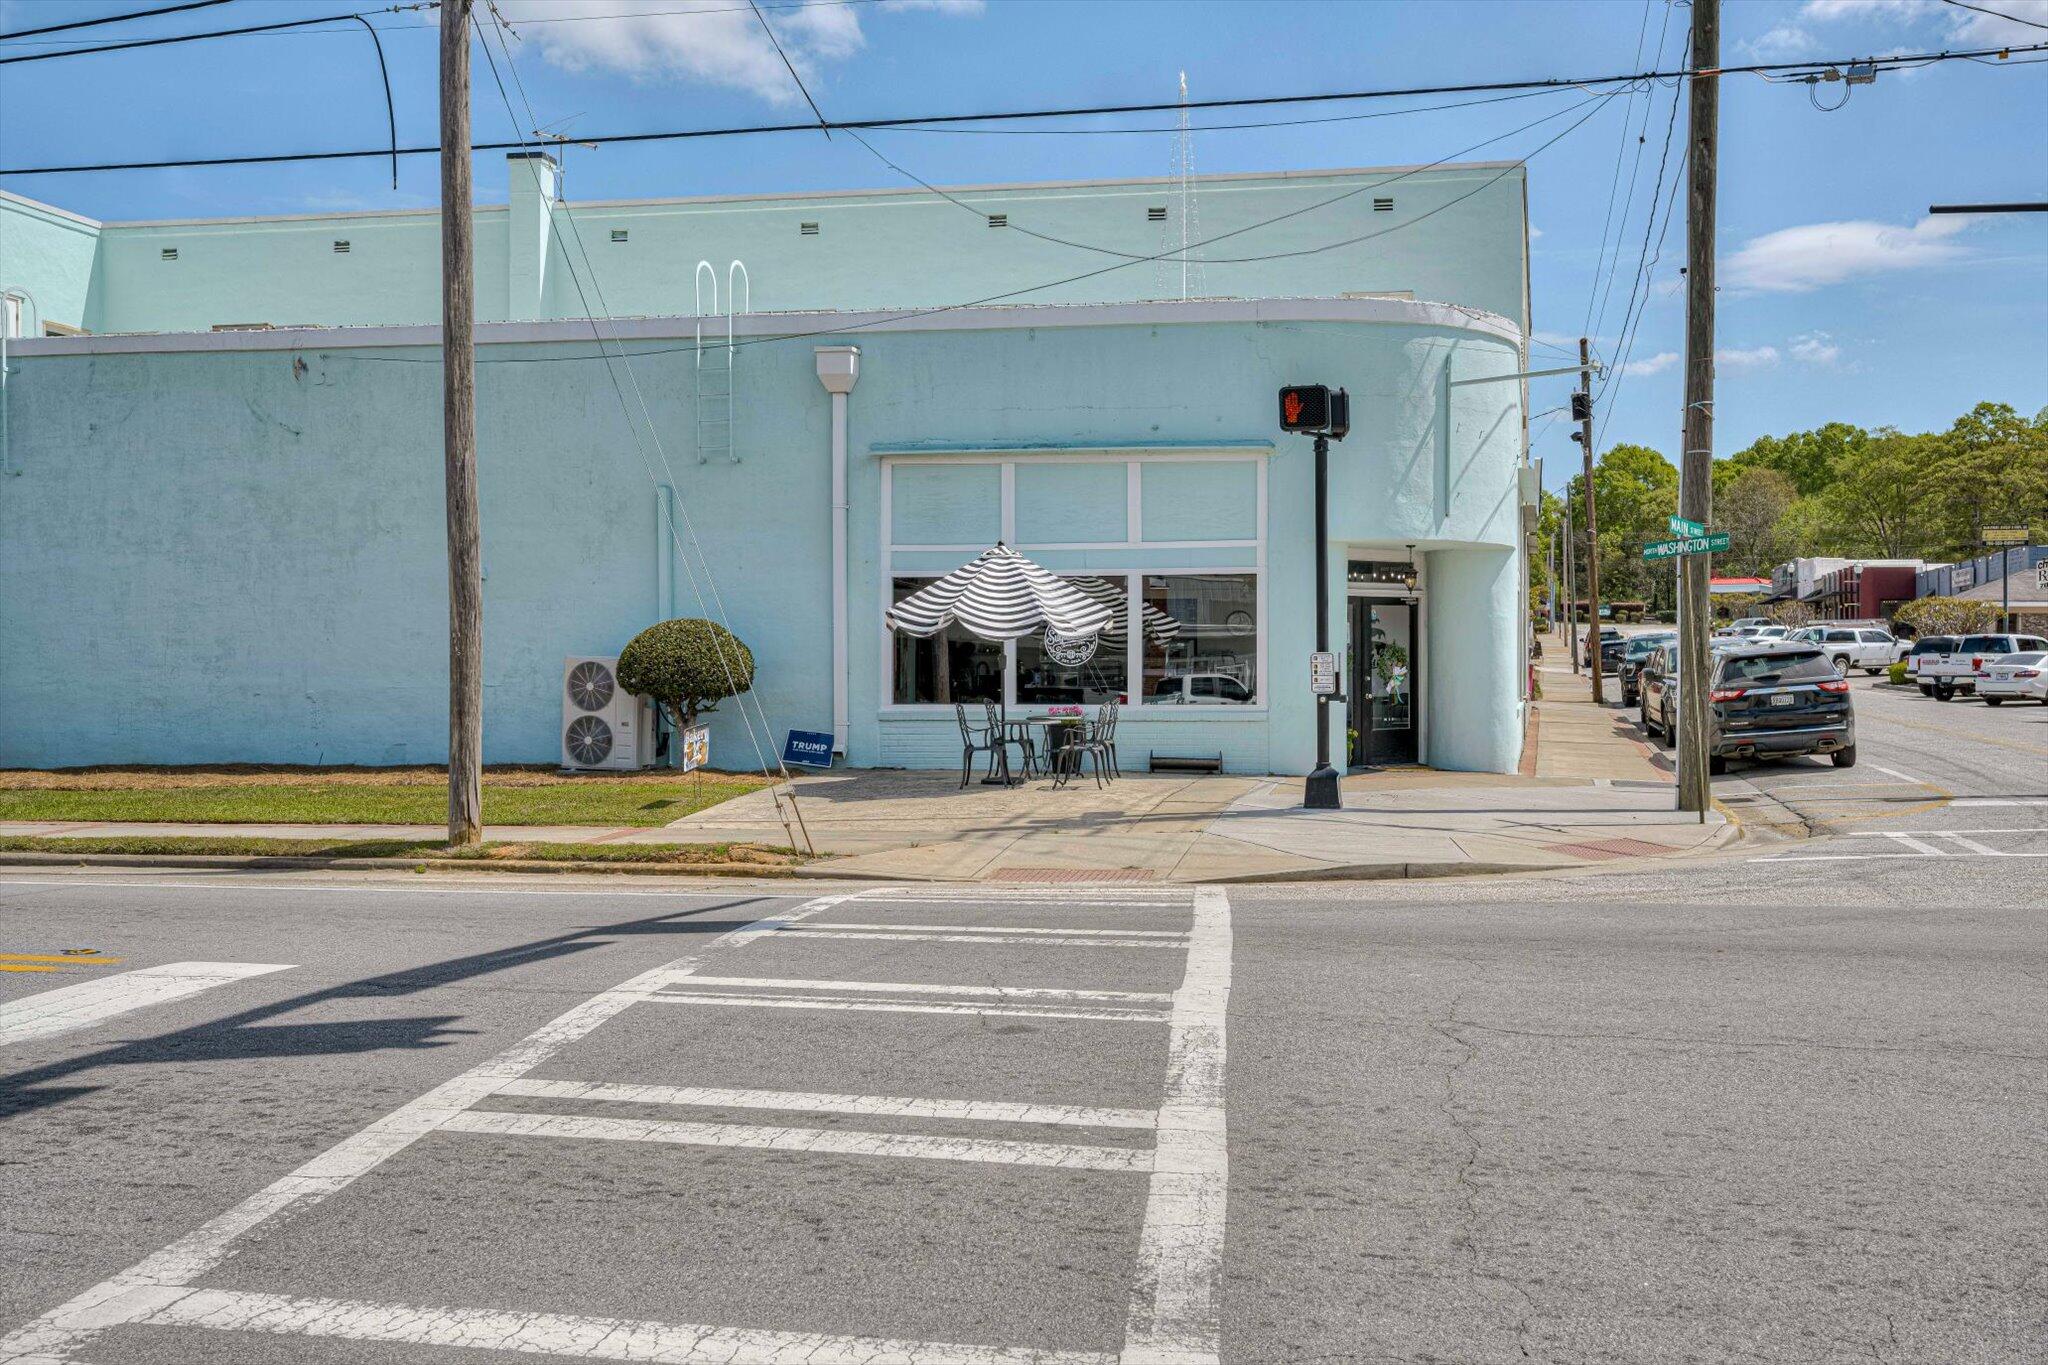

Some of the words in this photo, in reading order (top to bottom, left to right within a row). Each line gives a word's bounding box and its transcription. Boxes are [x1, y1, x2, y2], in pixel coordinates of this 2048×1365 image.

[1671, 518, 1689, 536] MAIN
[1657, 538, 1710, 556] WASHINGTON
[1711, 537, 1729, 547] STREET
[792, 740, 828, 752] TRUMP
